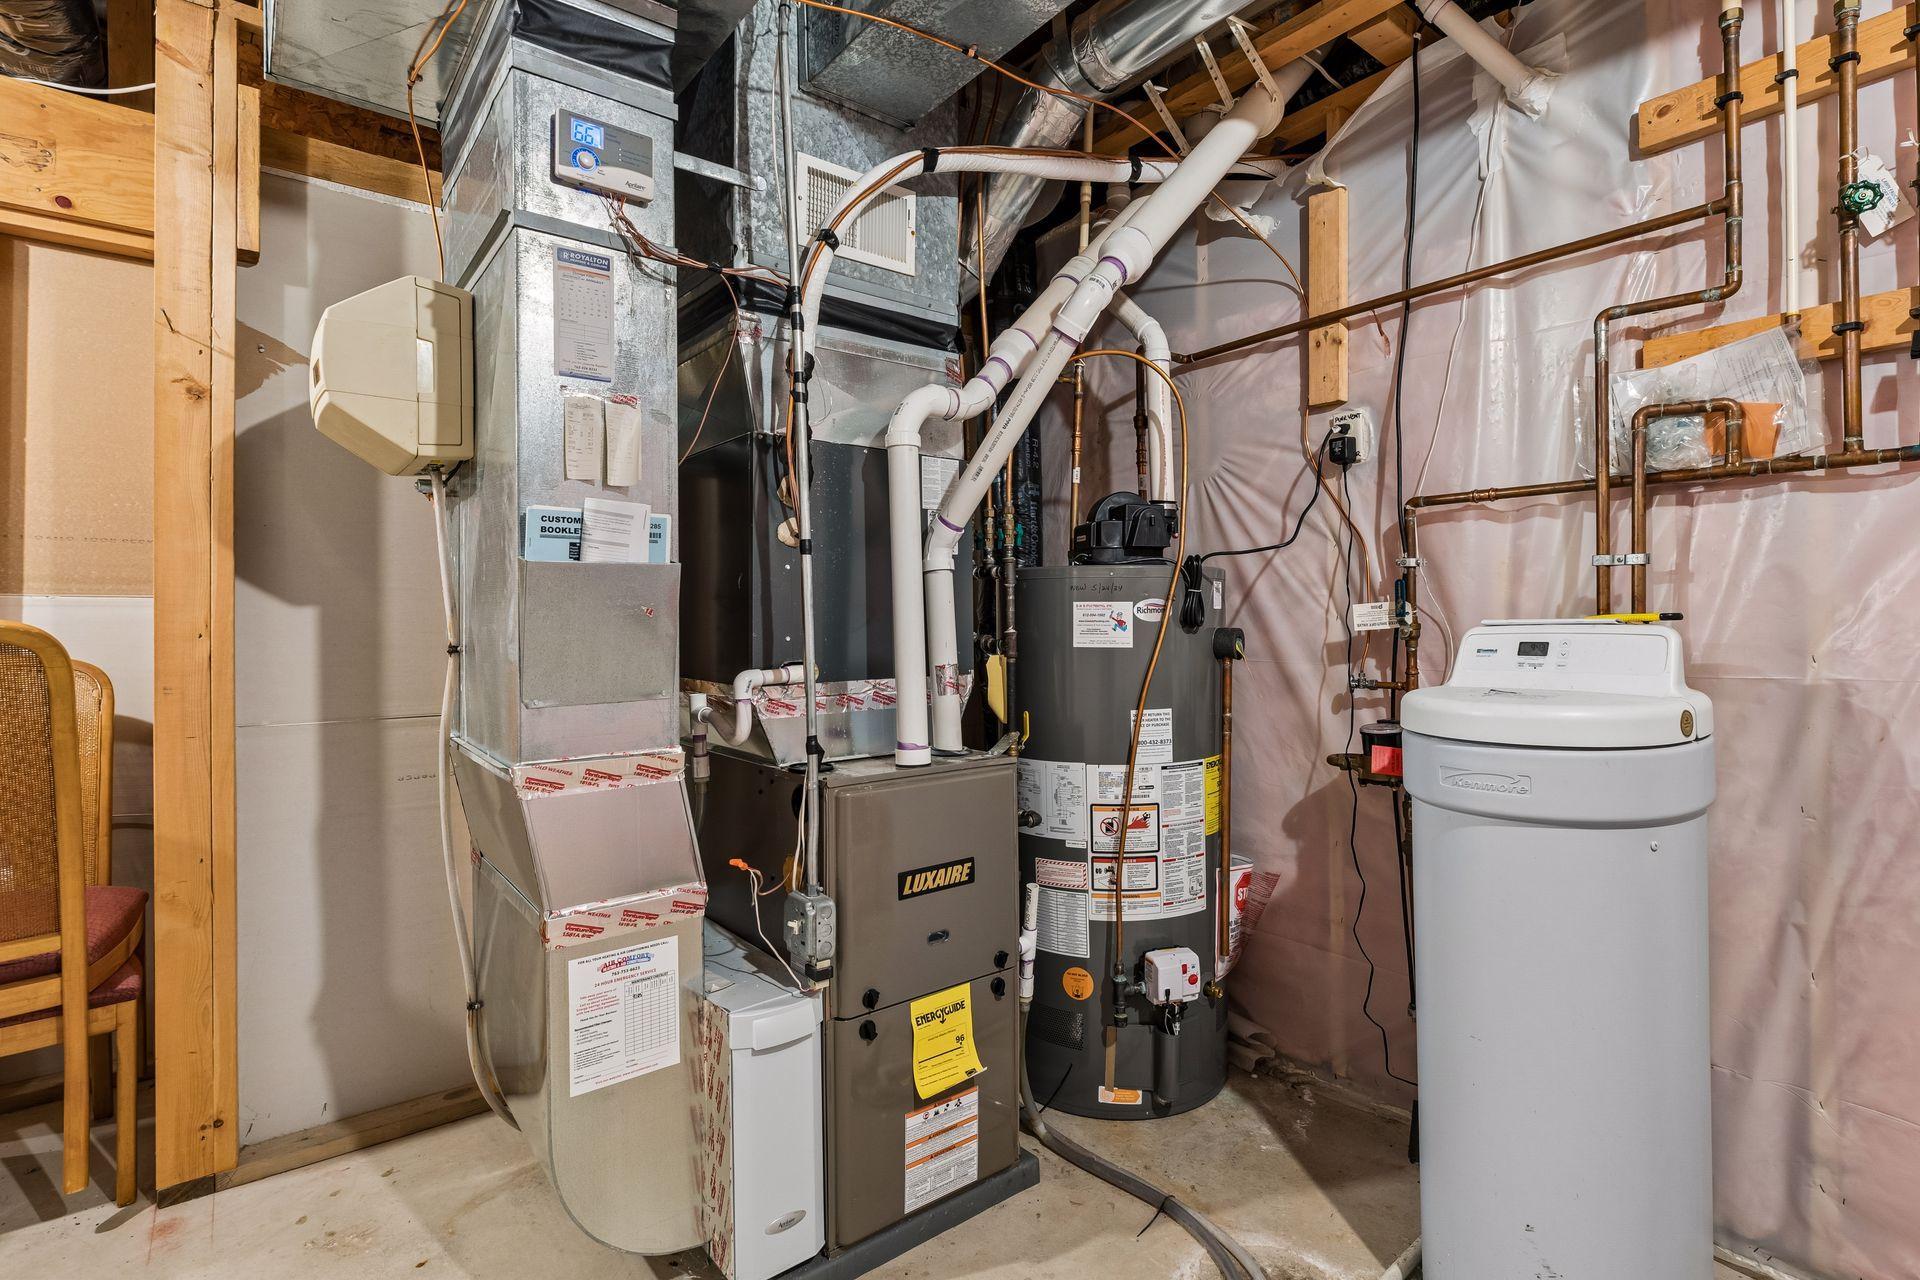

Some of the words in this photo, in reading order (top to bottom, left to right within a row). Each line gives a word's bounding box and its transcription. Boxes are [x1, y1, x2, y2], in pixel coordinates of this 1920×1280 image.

[574, 124, 594, 145] 66
[570, 252, 608, 265] ROYALTON
[541, 516, 584, 524] CUSTOM
[1136, 606, 1166, 614] Richmon
[585, 770, 622, 782] VentureTape
[526, 778, 565, 791] VentureTape
[1452, 776, 1528, 794] Kenmore
[903, 862, 972, 895] LUXAIRE
[1238, 888, 1248, 901] ST
[604, 960, 615, 968] AIR
[616, 952, 650, 964] COMFORT
[614, 973, 639, 983] EMERGENCY
[915, 1000, 965, 1026] ENERGYGUIDE
[956, 1034, 965, 1044] 96
